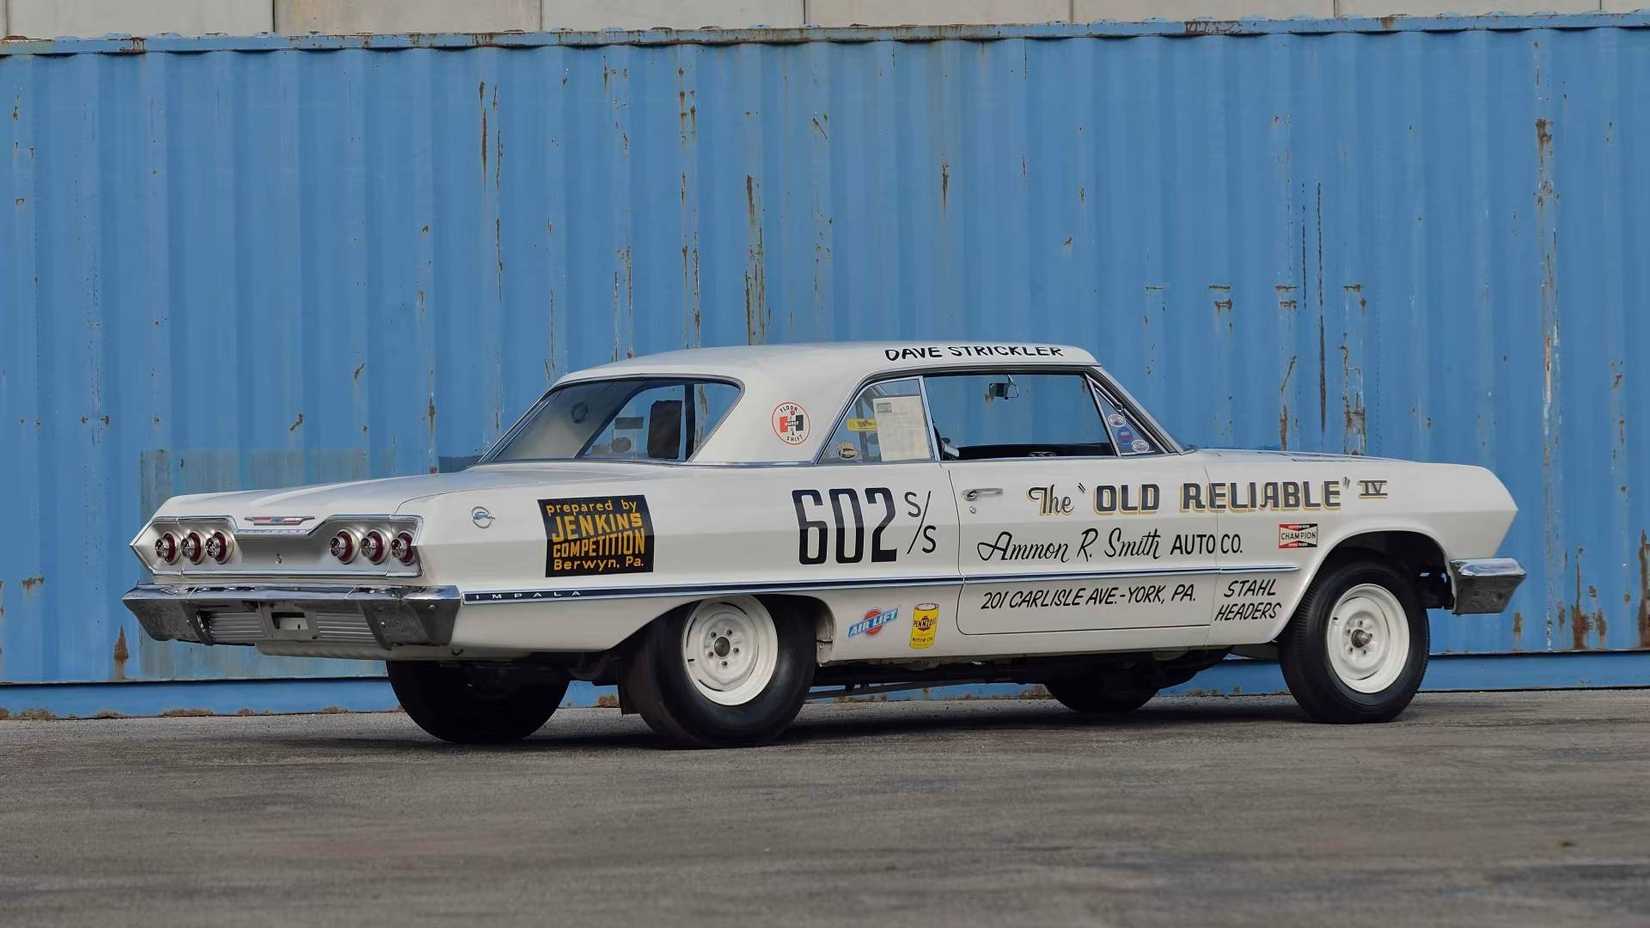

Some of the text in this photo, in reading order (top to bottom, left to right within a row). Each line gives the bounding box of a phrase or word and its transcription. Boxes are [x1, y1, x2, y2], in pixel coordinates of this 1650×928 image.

[885, 346, 1064, 361] DAVE STRICKLER
[546, 499, 637, 517] prepared by
[1027, 484, 1074, 515] The
[1358, 480, 1388, 499] IV
[551, 512, 643, 543] JENKINS
[792, 487, 898, 565] 602
[1280, 531, 1317, 541] CHAMPION
[553, 528, 645, 558] COMPETITION
[977, 527, 1243, 563] Ammon R. Smith AUTO CO.
[625, 556, 644, 567] Pa.
[475, 592, 581, 600] IMPALA
[981, 592, 1004, 610] 201
[1009, 587, 1087, 609] CARLISLE
[1171, 583, 1197, 602] PA.
[1224, 578, 1276, 598] STAHL
[848, 609, 898, 637] AIR LIFT
[1214, 602, 1282, 621] HEADERS
